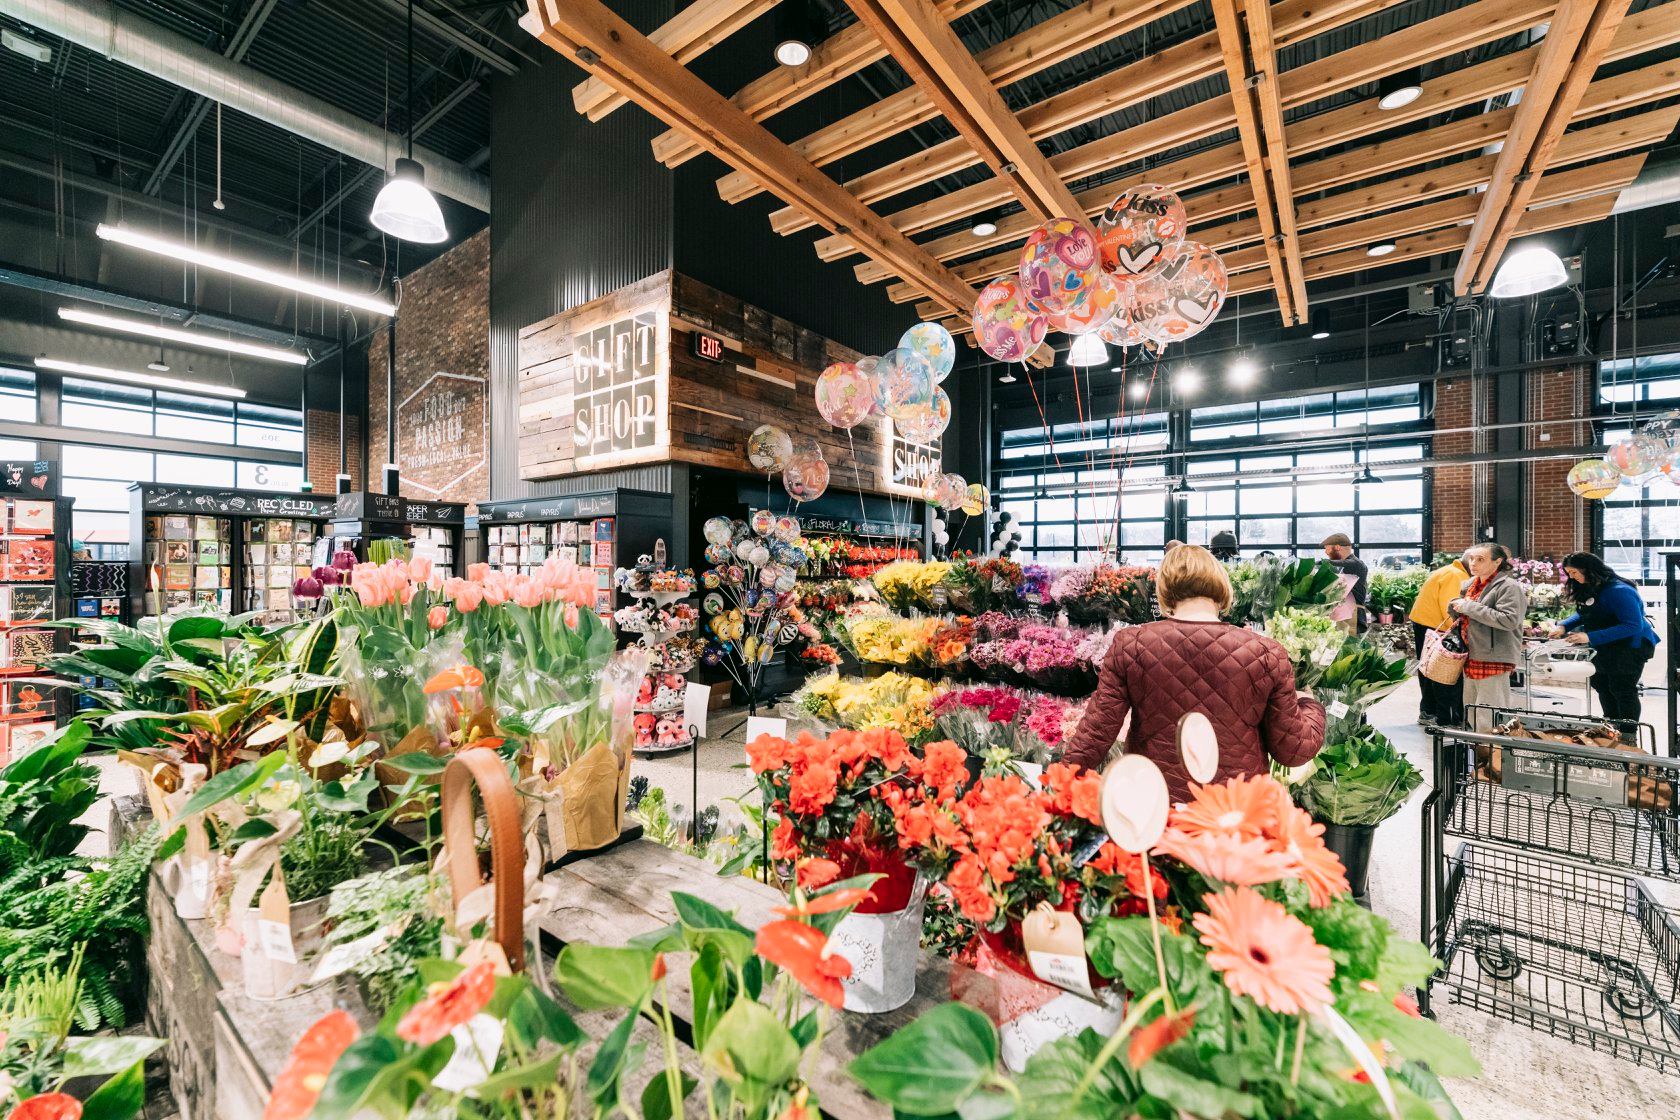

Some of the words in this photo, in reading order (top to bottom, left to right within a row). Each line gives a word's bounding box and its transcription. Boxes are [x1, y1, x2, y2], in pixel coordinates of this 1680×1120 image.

[575, 325, 655, 384] GIFT
[701, 336, 719, 358] EXIT
[415, 416, 462, 450] PASSION
[574, 395, 654, 447] SHOP
[257, 498, 313, 511] RECYCLED
